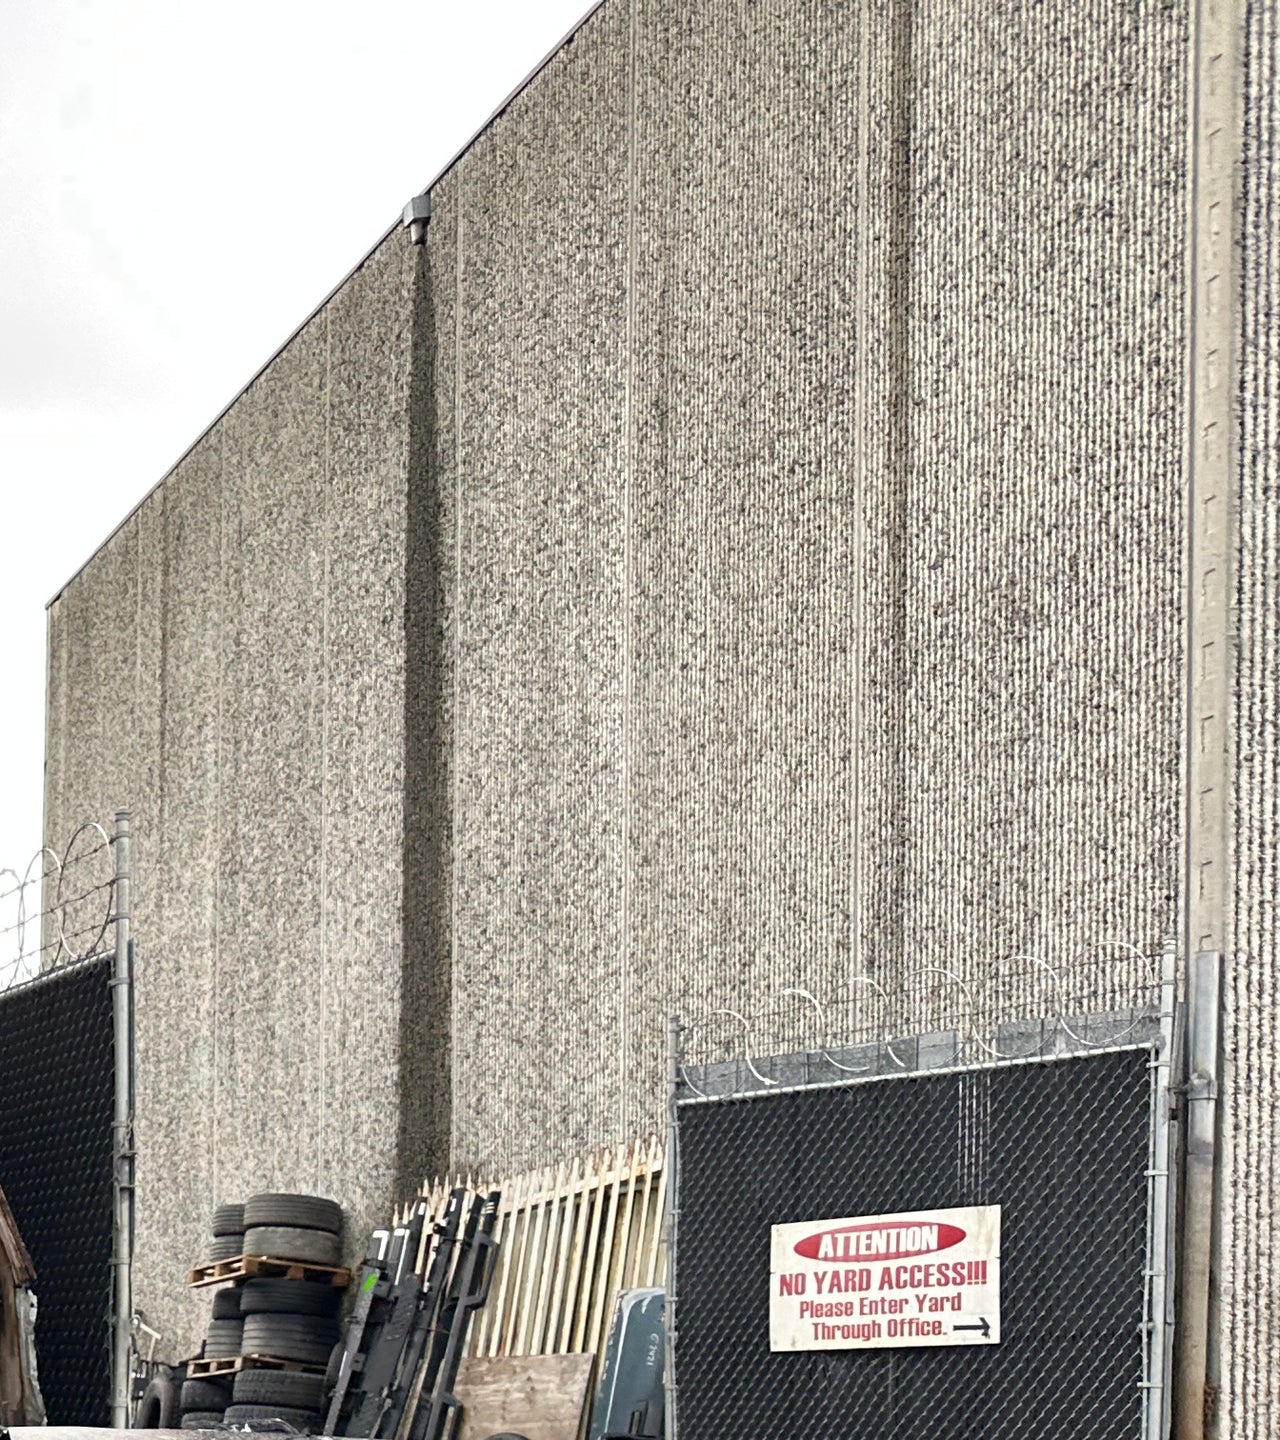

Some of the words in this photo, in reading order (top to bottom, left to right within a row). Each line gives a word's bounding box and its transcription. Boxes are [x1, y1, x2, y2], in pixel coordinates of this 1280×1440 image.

[818, 1225, 939, 1259] ATTENTION
[779, 1272, 807, 1296] NO
[814, 1268, 871, 1295] YARD
[878, 1260, 987, 1291] ACCESS!!!
[799, 1300, 854, 1319] Please
[859, 1296, 909, 1315] Enter
[915, 1292, 962, 1313] Yard
[812, 1319, 881, 1342] Through
